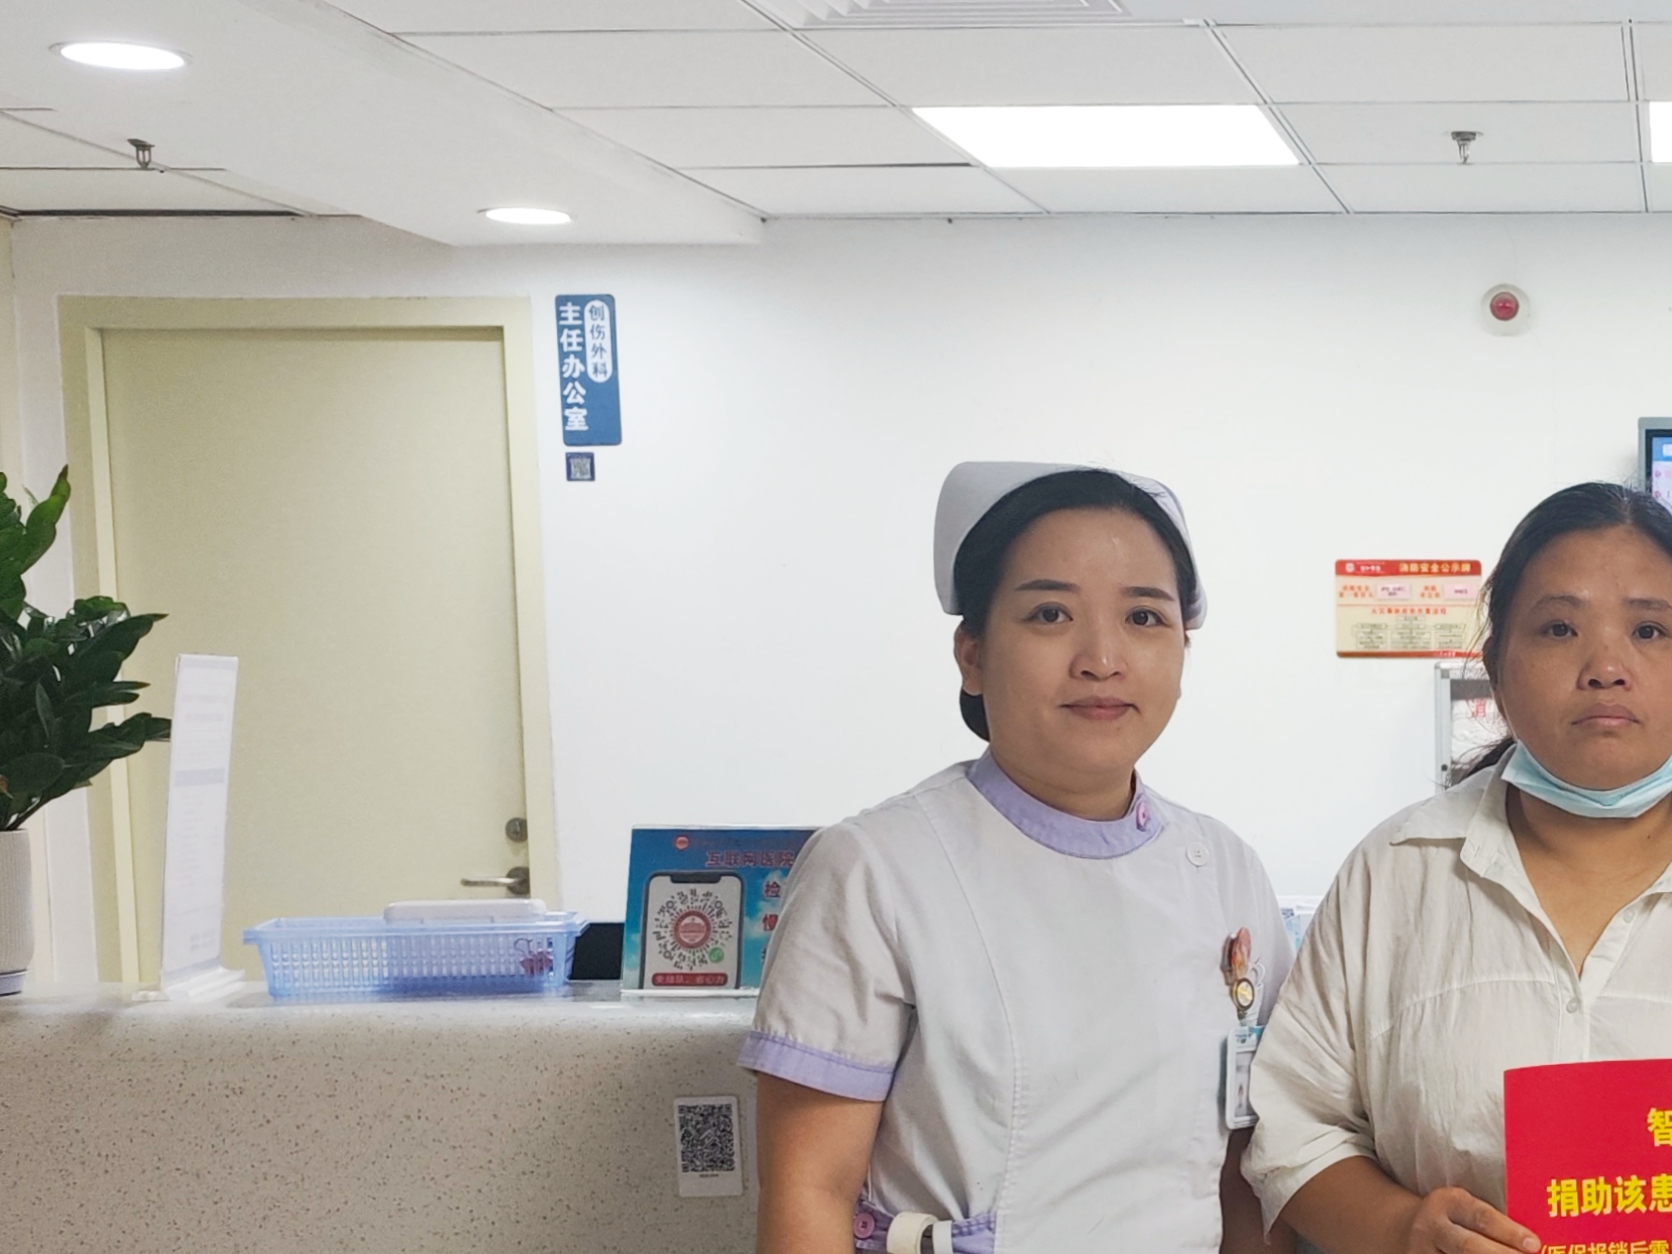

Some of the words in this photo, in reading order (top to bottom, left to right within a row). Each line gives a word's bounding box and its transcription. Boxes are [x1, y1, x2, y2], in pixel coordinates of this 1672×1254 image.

[559, 302, 589, 431] 主任办公室
[588, 304, 608, 378] 创伤外科
